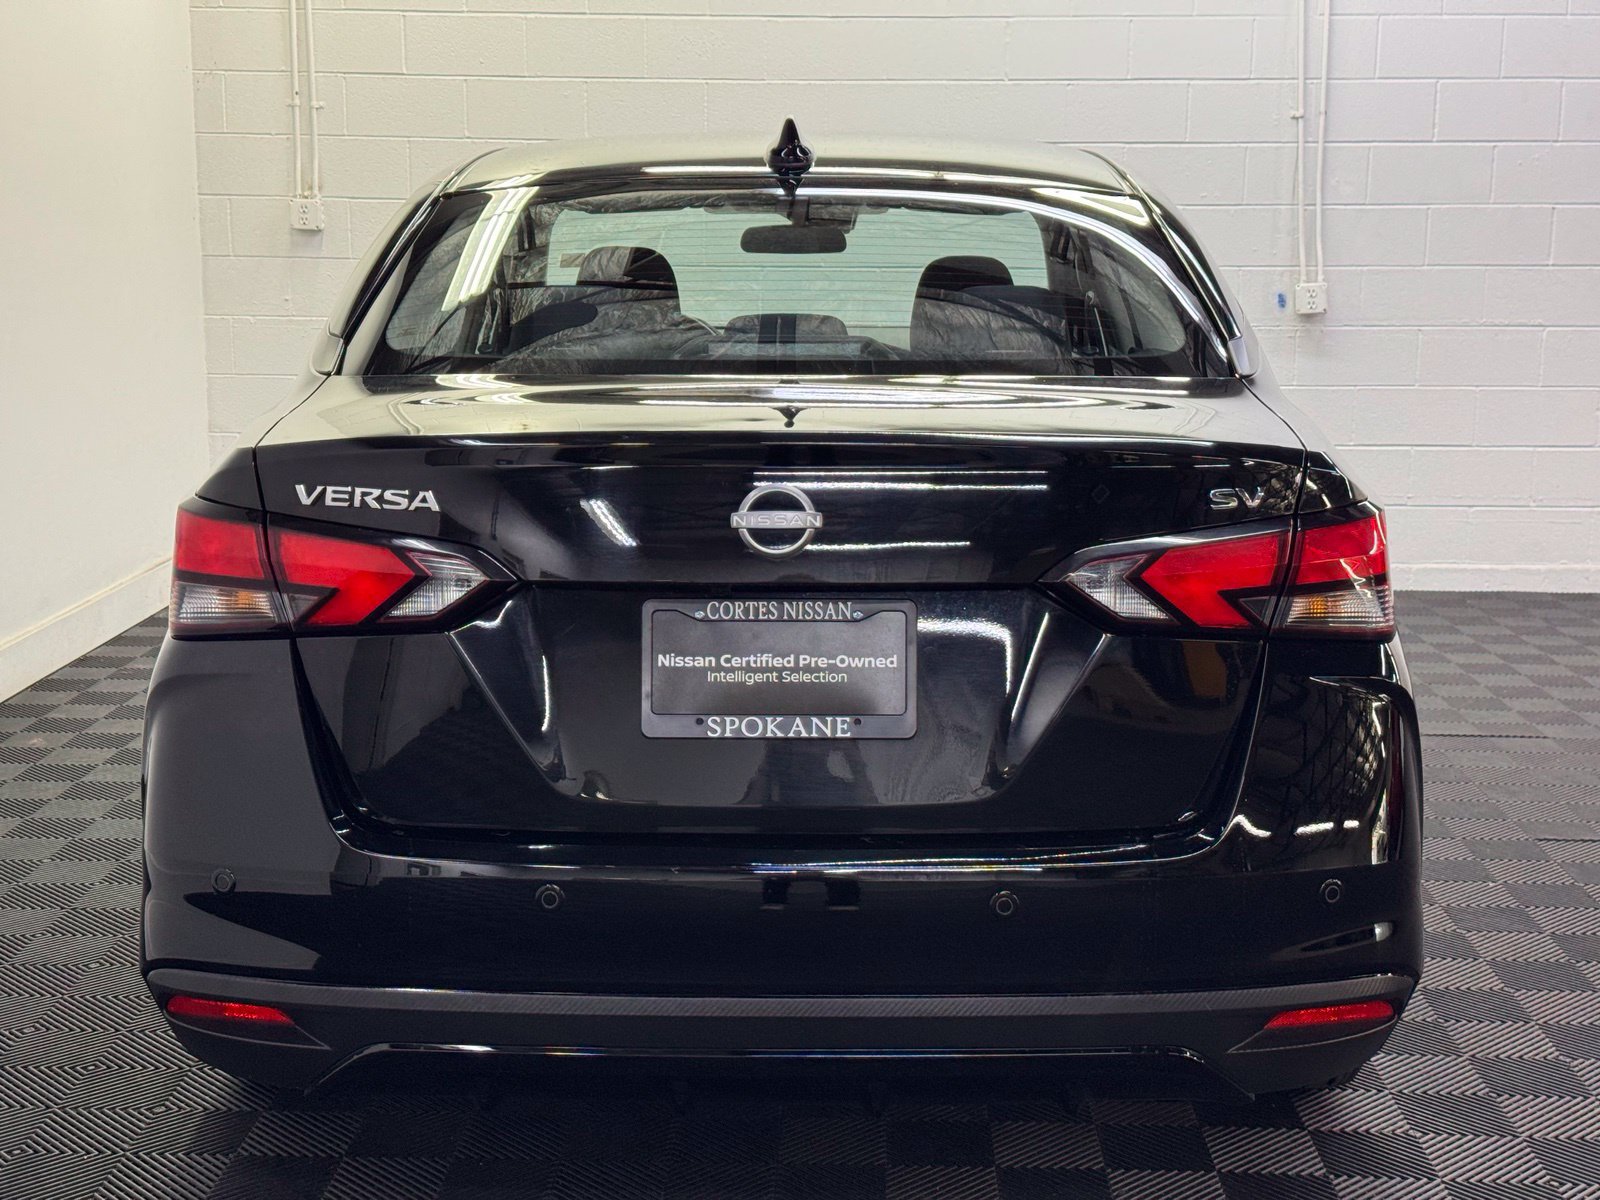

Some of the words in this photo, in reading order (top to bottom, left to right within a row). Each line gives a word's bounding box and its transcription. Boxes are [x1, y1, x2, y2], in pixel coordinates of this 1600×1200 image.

[295, 484, 441, 512] VERSA
[1210, 488, 1265, 510] SV
[733, 515, 820, 526] NISSAN
[706, 601, 778, 620] CORTES
[783, 601, 852, 620] NISSAN
[657, 654, 716, 668] Nissan
[720, 654, 795, 668] Certified
[799, 654, 898, 668] Pre-Owned
[707, 671, 778, 685] Intelligent
[782, 671, 848, 683] Selection
[706, 716, 851, 737] SPOKANE
